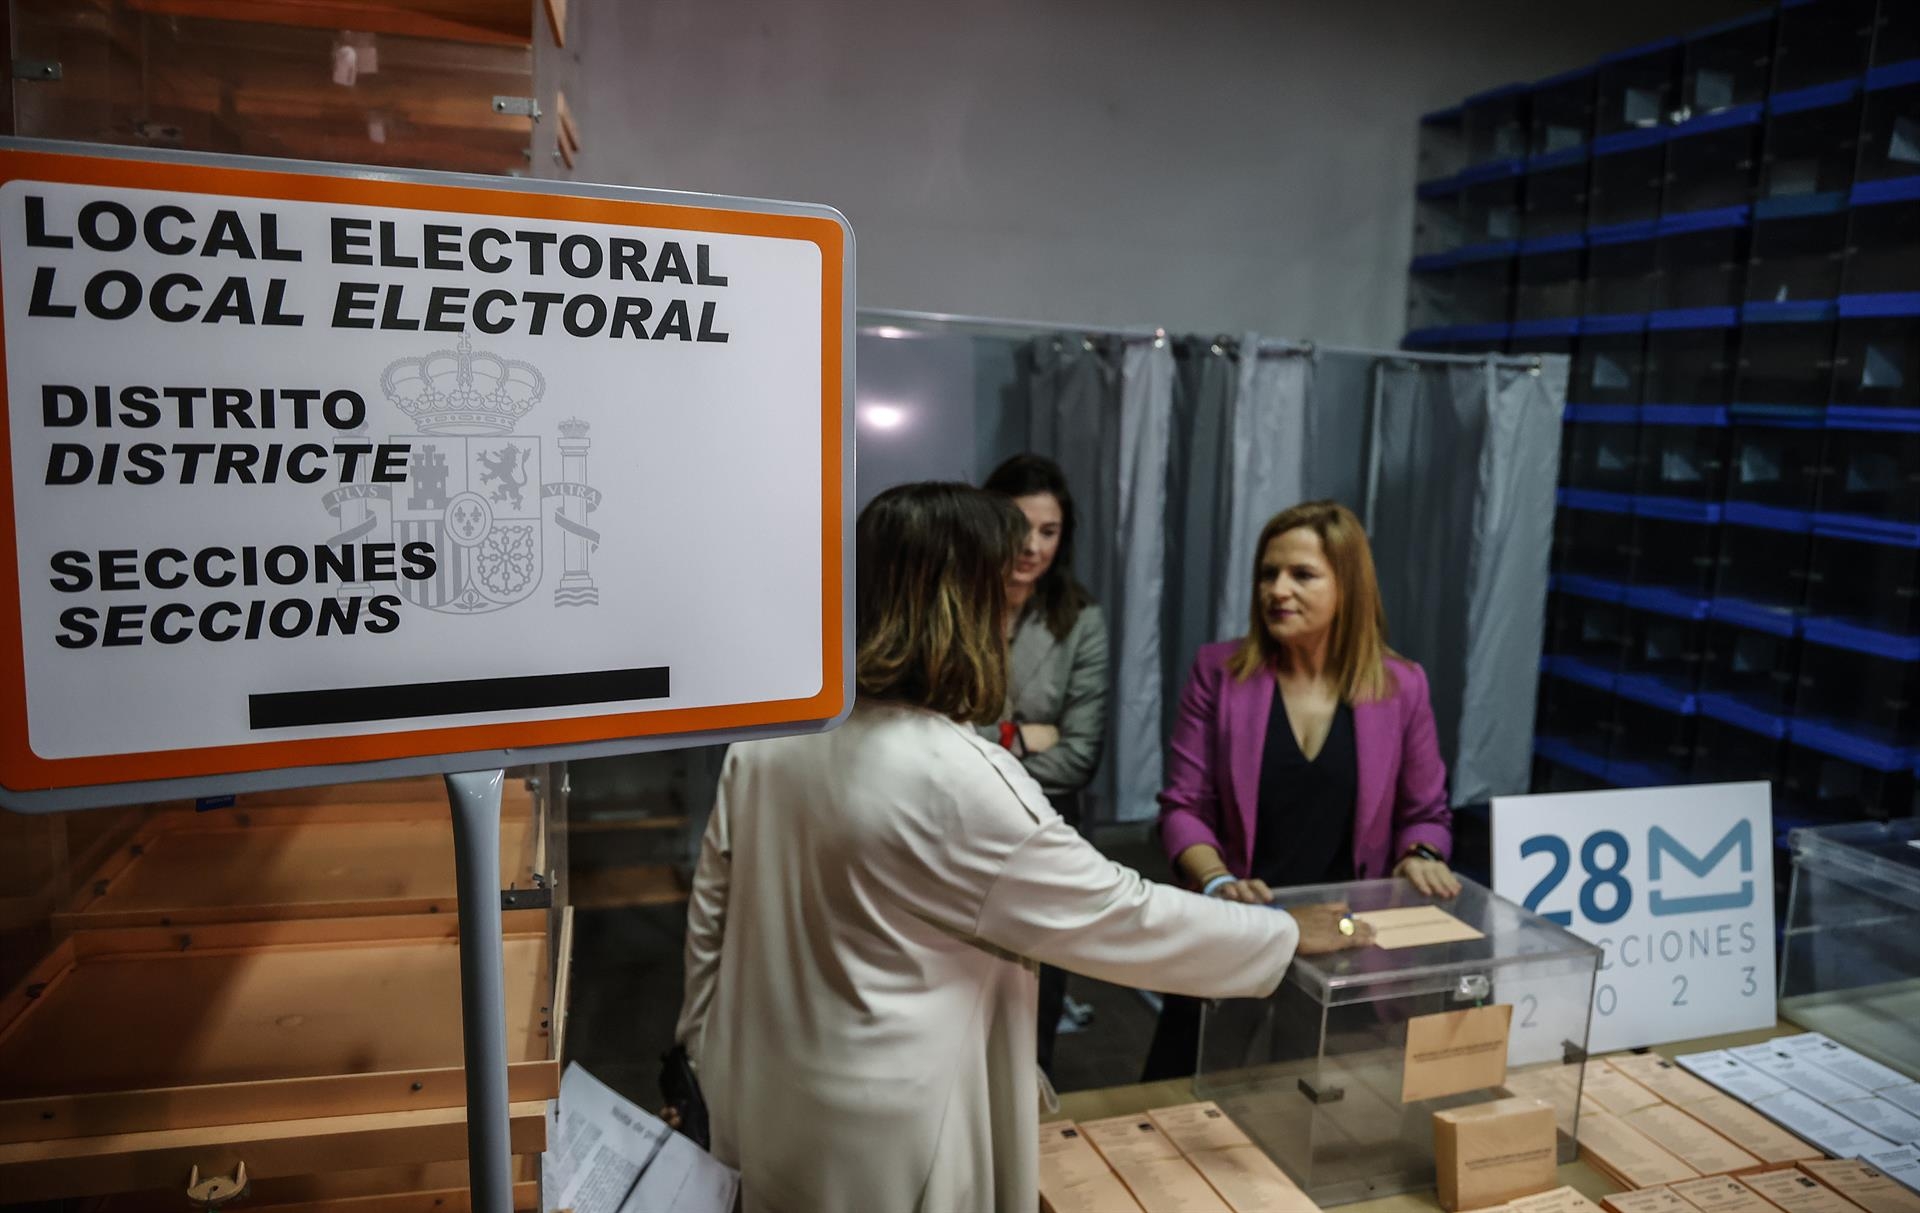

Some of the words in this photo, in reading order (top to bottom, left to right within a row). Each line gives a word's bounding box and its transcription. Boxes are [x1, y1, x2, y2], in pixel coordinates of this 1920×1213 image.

[24, 195, 303, 262] LOCAL
[330, 217, 728, 287] ELECTORAL
[27, 266, 305, 327] LOCAL
[331, 281, 730, 343] ELECTORAL
[41, 384, 366, 430] DISTRITO
[44, 442, 412, 486] DISTRICTE
[49, 541, 437, 593] SECCIONES
[54, 594, 402, 650] SECCIONS
[1596, 921, 1756, 972] CCIONES
